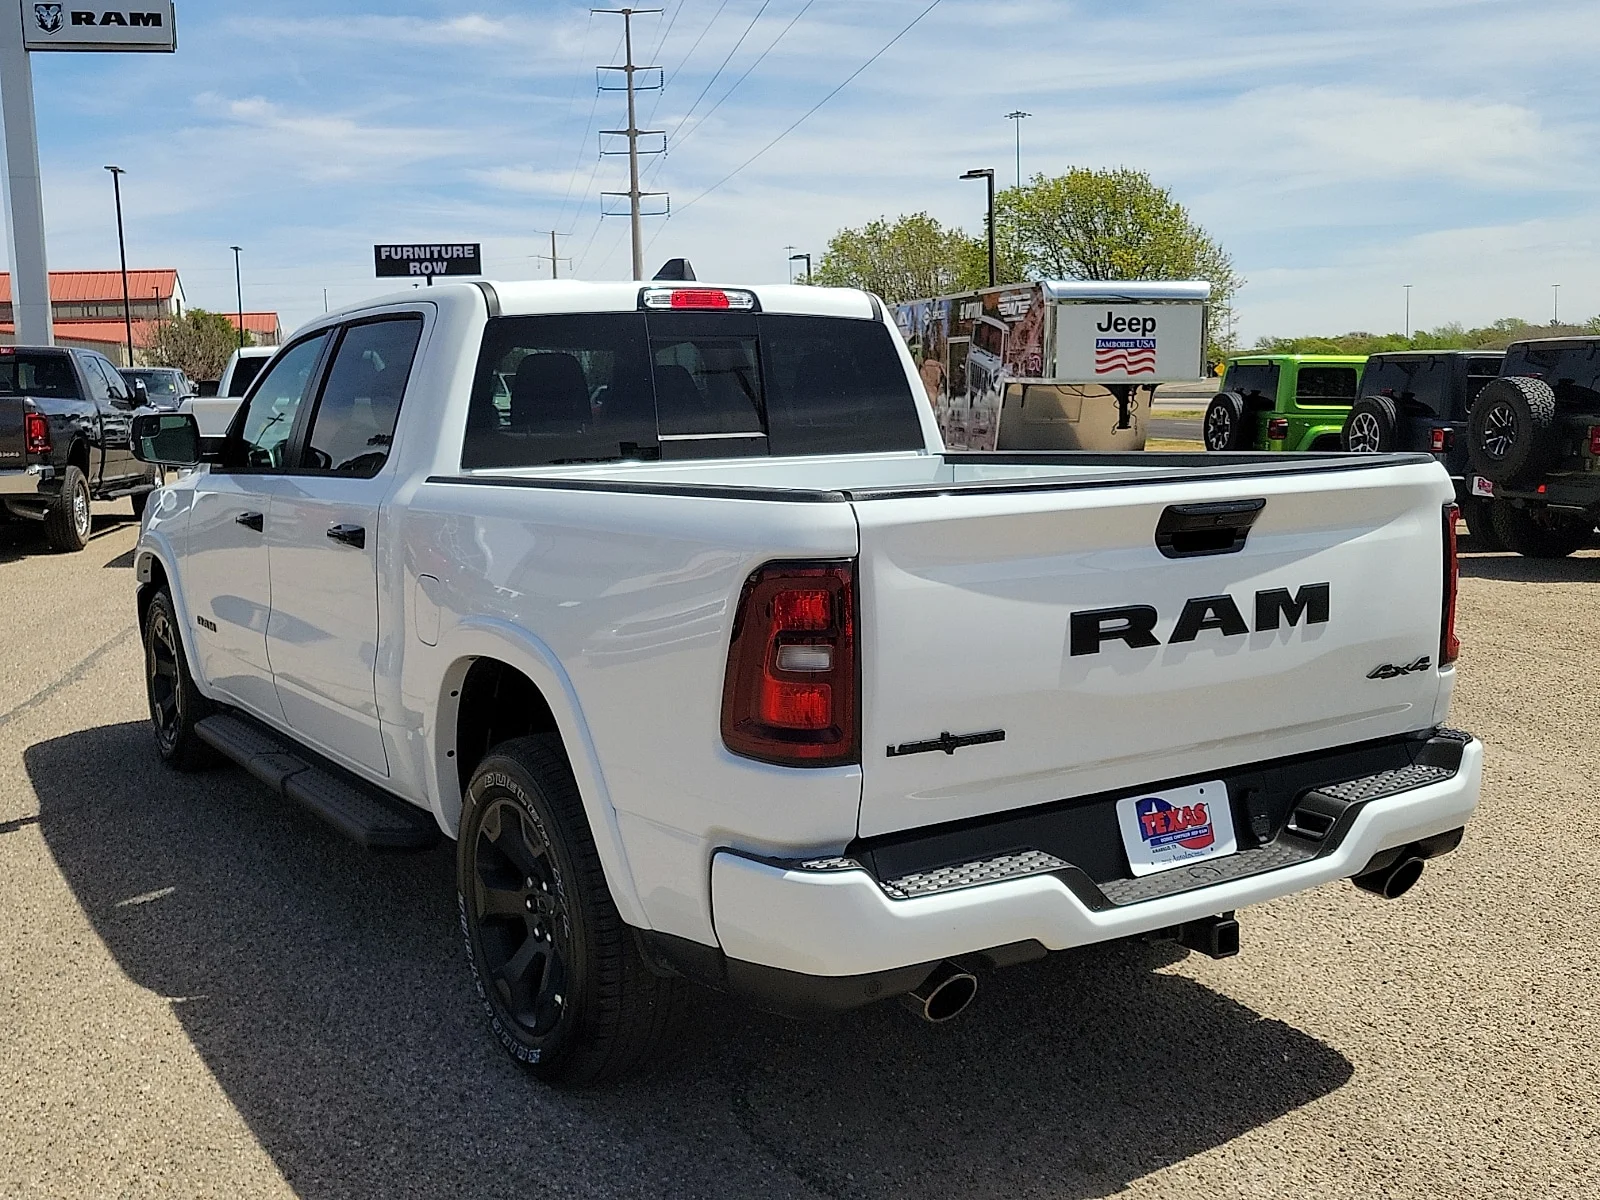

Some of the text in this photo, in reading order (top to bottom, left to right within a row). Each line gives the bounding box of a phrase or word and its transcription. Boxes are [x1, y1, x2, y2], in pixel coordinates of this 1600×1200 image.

[70, 11, 163, 27] RAM
[381, 245, 475, 260] FURNITURE
[409, 261, 448, 275] ROW
[1096, 311, 1157, 338] Jeep
[1136, 340, 1155, 348] USA
[1070, 582, 1331, 657] RAM
[1141, 803, 1208, 837] TEXAS
